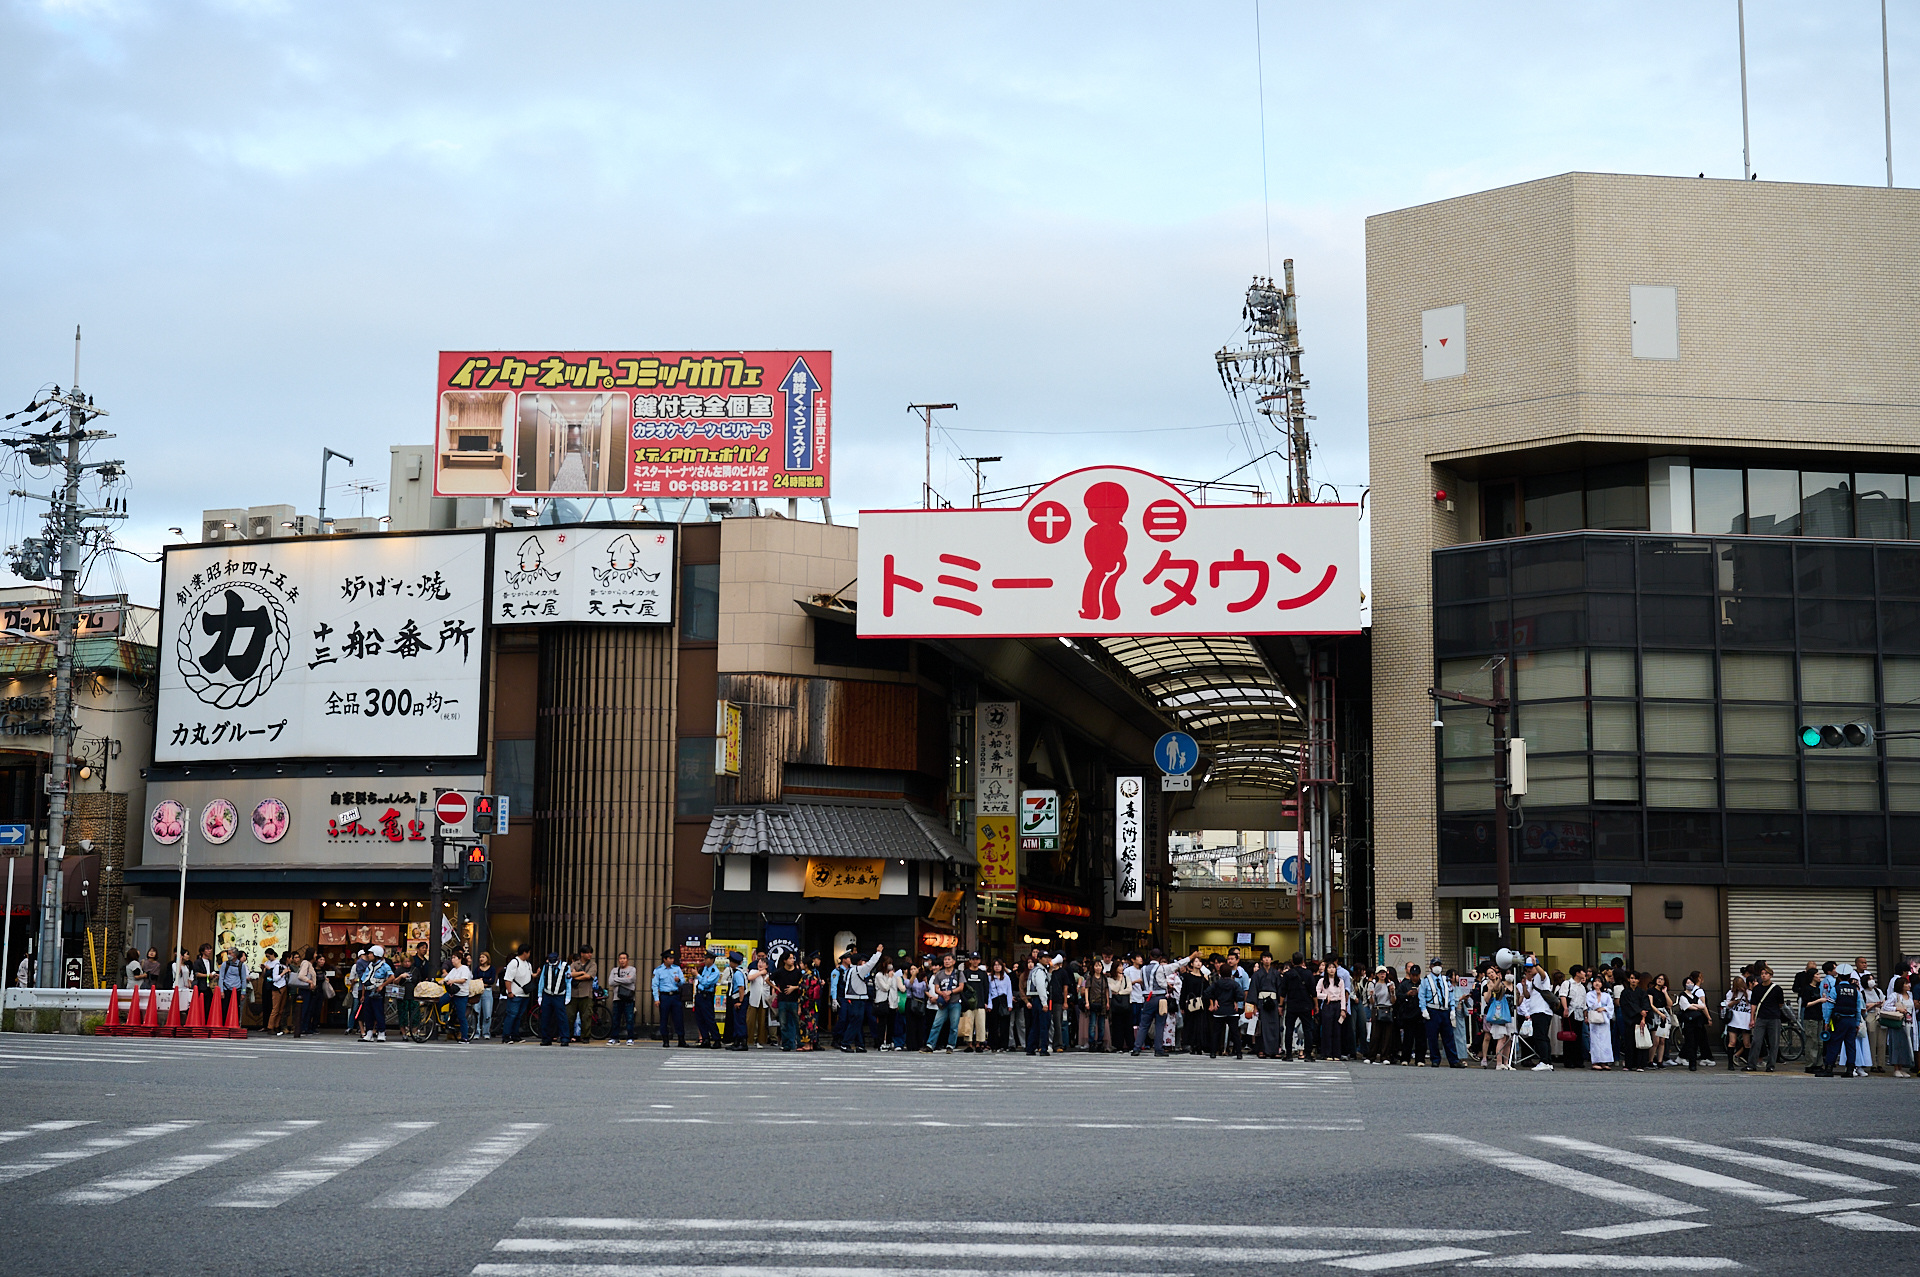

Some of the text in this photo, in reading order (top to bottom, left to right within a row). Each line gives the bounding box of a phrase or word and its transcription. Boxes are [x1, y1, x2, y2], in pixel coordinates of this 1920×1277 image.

[633, 395, 773, 418] 鍵付完全個室
[816, 397, 827, 464] 十三駅東口すぐ
[634, 446, 769, 463] メディアカフェポパイ
[634, 481, 769, 492] 十三店 06-6886-2112
[773, 473, 824, 489] 24時間営業
[176, 559, 301, 607] 創業昭和四十五年
[340, 570, 451, 603] 炉ばた焼
[883, 553, 1054, 618] トミー
[1143, 549, 1338, 616] タウン
[308, 618, 476, 671] 十三船番所
[170, 719, 288, 746] 力丸グループ
[1022, 839, 1038, 849] ATM
[1523, 911, 1567, 920] 三菱UFJ銀行
